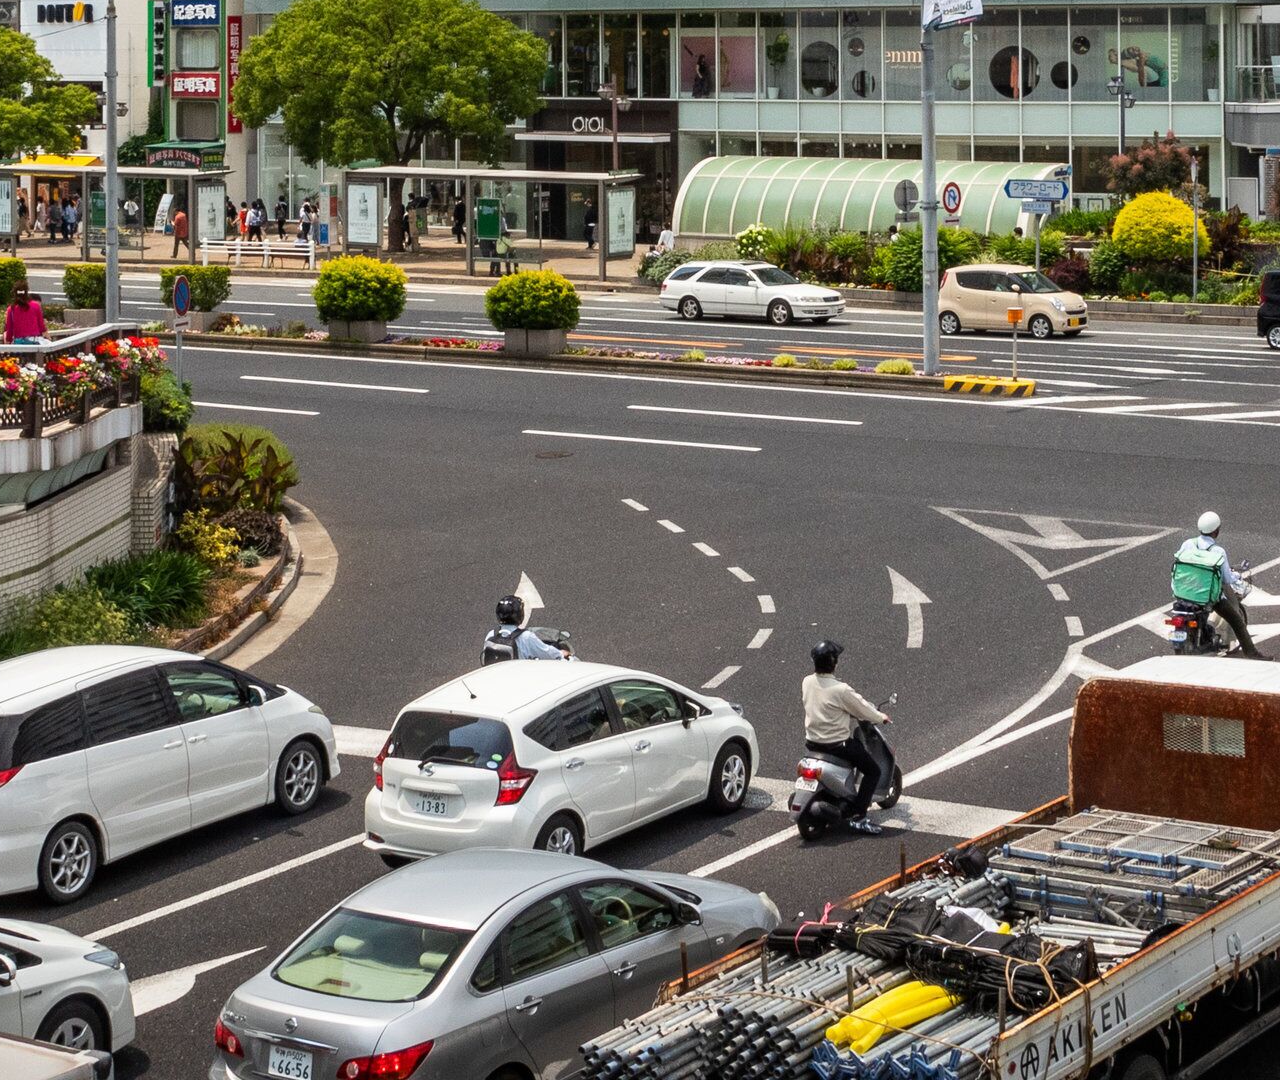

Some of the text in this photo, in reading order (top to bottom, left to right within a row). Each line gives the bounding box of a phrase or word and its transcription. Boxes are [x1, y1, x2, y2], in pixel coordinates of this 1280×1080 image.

[173, 3, 217, 21] 記念写真
[173, 76, 217, 94] 証明写真
[1013, 182, 1060, 192] フラワーロード
[421, 800, 446, 814] 13-83
[1047, 990, 1127, 1063] AKIKEN
[277, 1059, 310, 1080] 66-56
